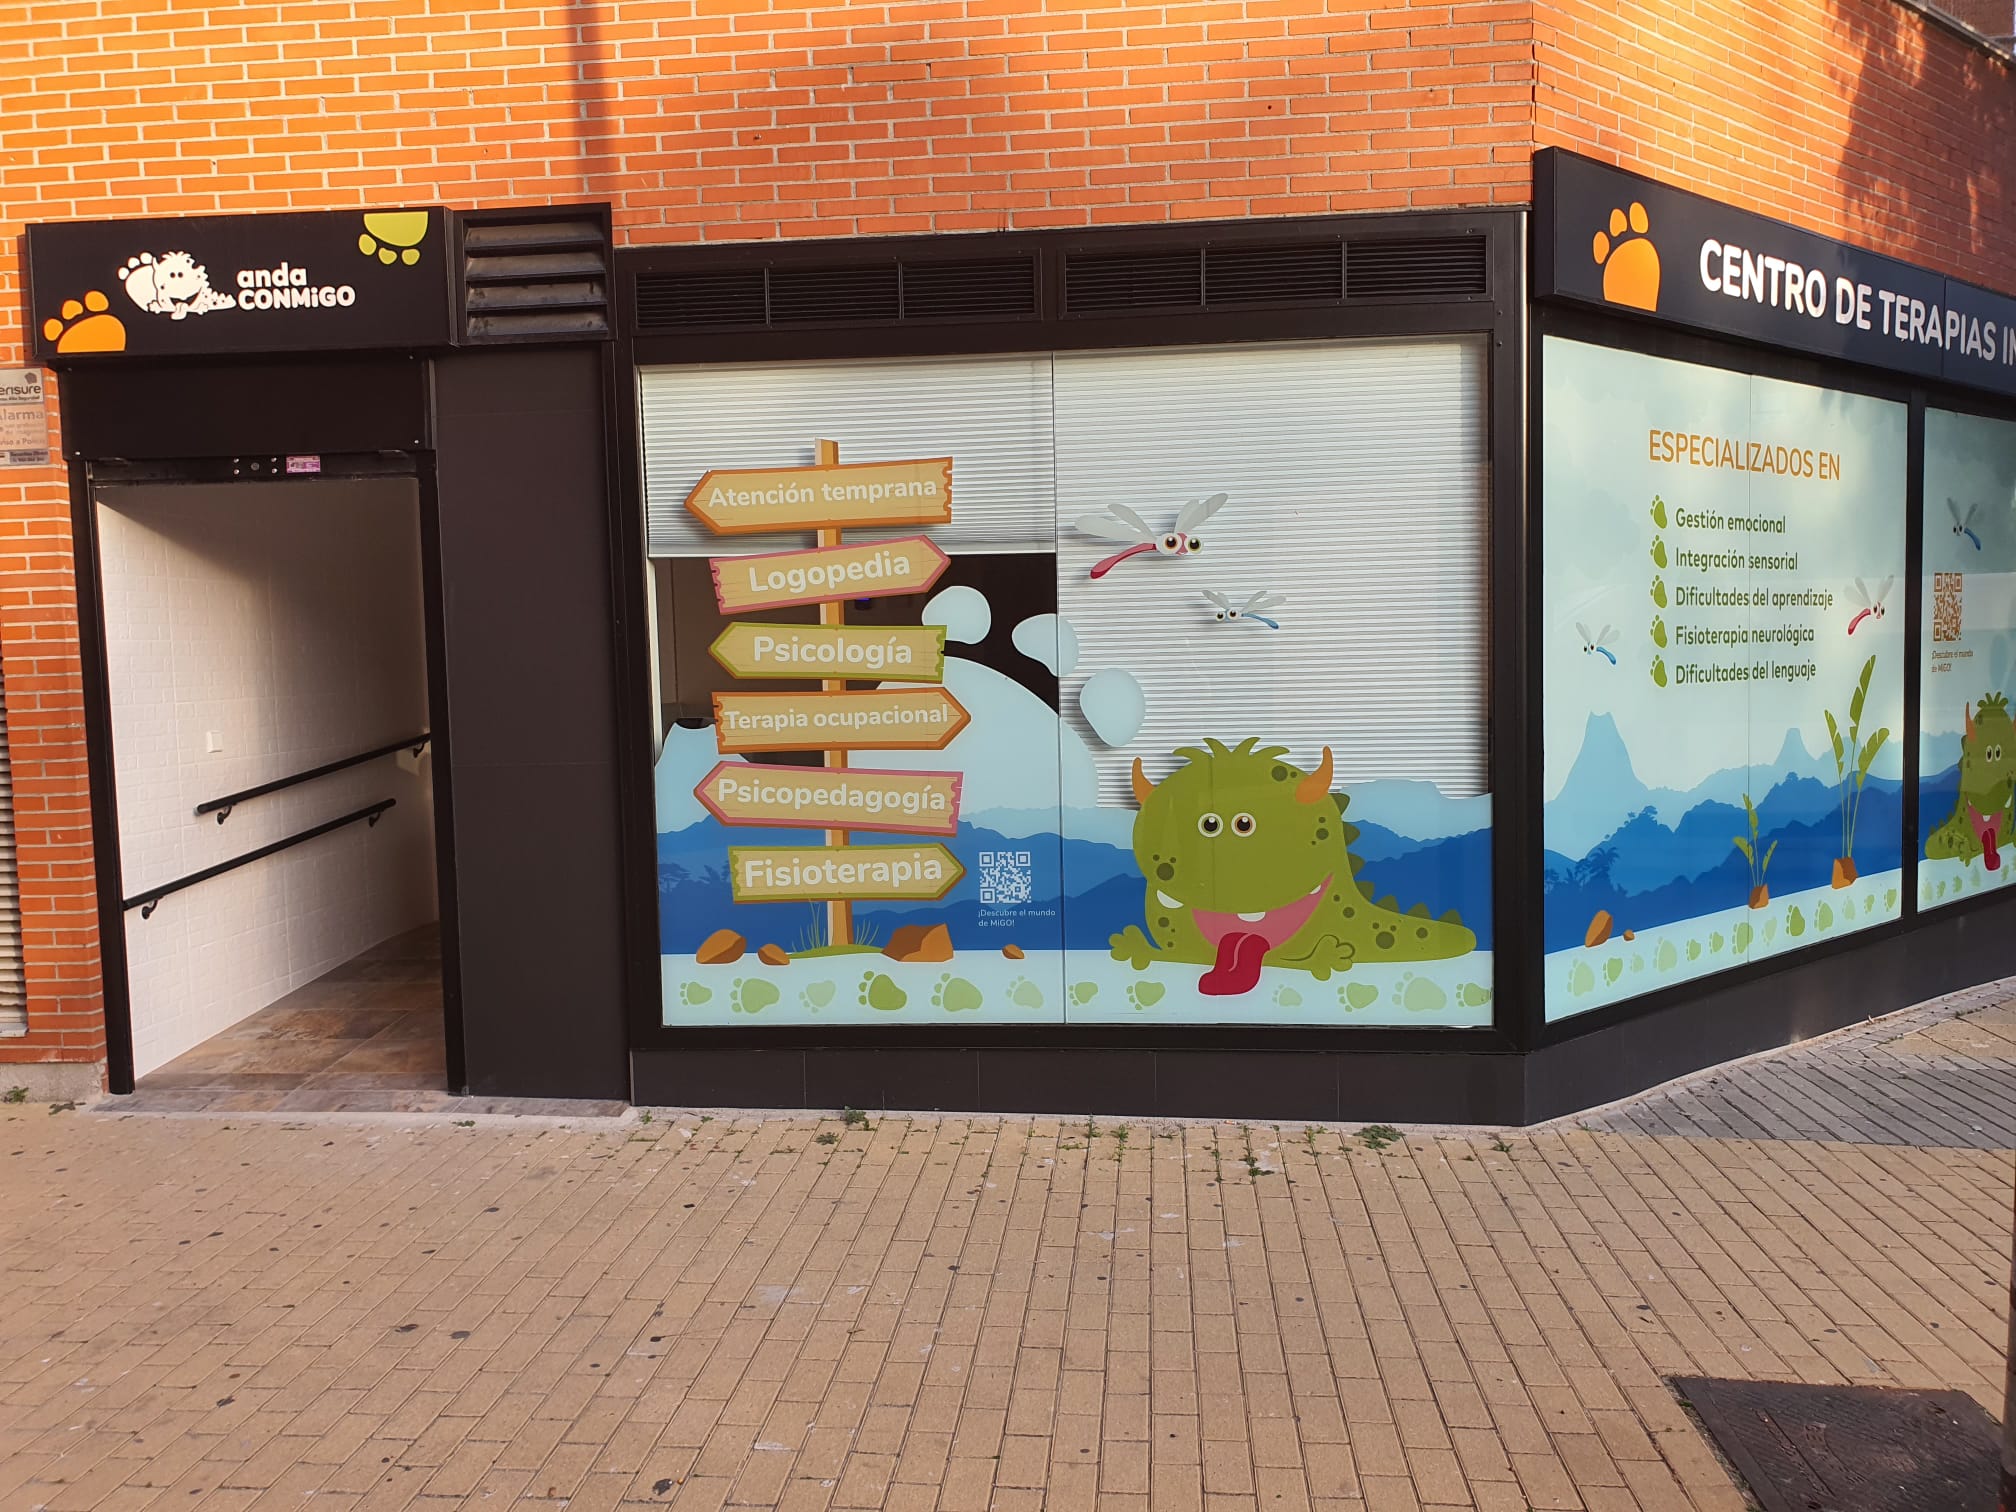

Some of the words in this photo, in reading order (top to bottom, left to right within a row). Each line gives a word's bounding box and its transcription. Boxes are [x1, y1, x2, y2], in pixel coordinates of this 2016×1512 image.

[236, 261, 307, 288] anda
[1700, 239, 1827, 319] CENTRO
[1835, 276, 1873, 331] DE
[1878, 288, 1997, 362] TERAPIAS
[0, 385, 41, 396] erisure
[1649, 429, 1814, 478] ESPECIALIZADOS
[1818, 451, 1840, 481] EN
[708, 482, 815, 508] Atención
[821, 480, 937, 503] temprana
[1675, 507, 1724, 530] Gestión
[1727, 514, 1786, 534] emocional
[749, 550, 911, 594] Logopedia
[1675, 547, 1745, 573] Integración
[1748, 552, 1798, 571] sensorial
[1675, 586, 1749, 606] Dificultades
[1752, 587, 1769, 606] del
[1772, 589, 1833, 611] aprendizaje
[1675, 625, 1748, 648] Fisioterapia
[1751, 624, 1815, 647] neurológica
[753, 635, 913, 670] Psicología
[1675, 662, 1749, 685] Dificultades
[1752, 661, 1769, 680] del
[1771, 659, 1817, 683] lenguaje
[724, 708, 809, 731] Terapia
[813, 703, 948, 730] ocupacional
[717, 778, 946, 814] Psicopedagogía
[744, 852, 942, 887] Fisioterapia
[978, 909, 1017, 918] ¡Descubre
[1019, 909, 1026, 917] el
[1028, 909, 1056, 917] mundo
